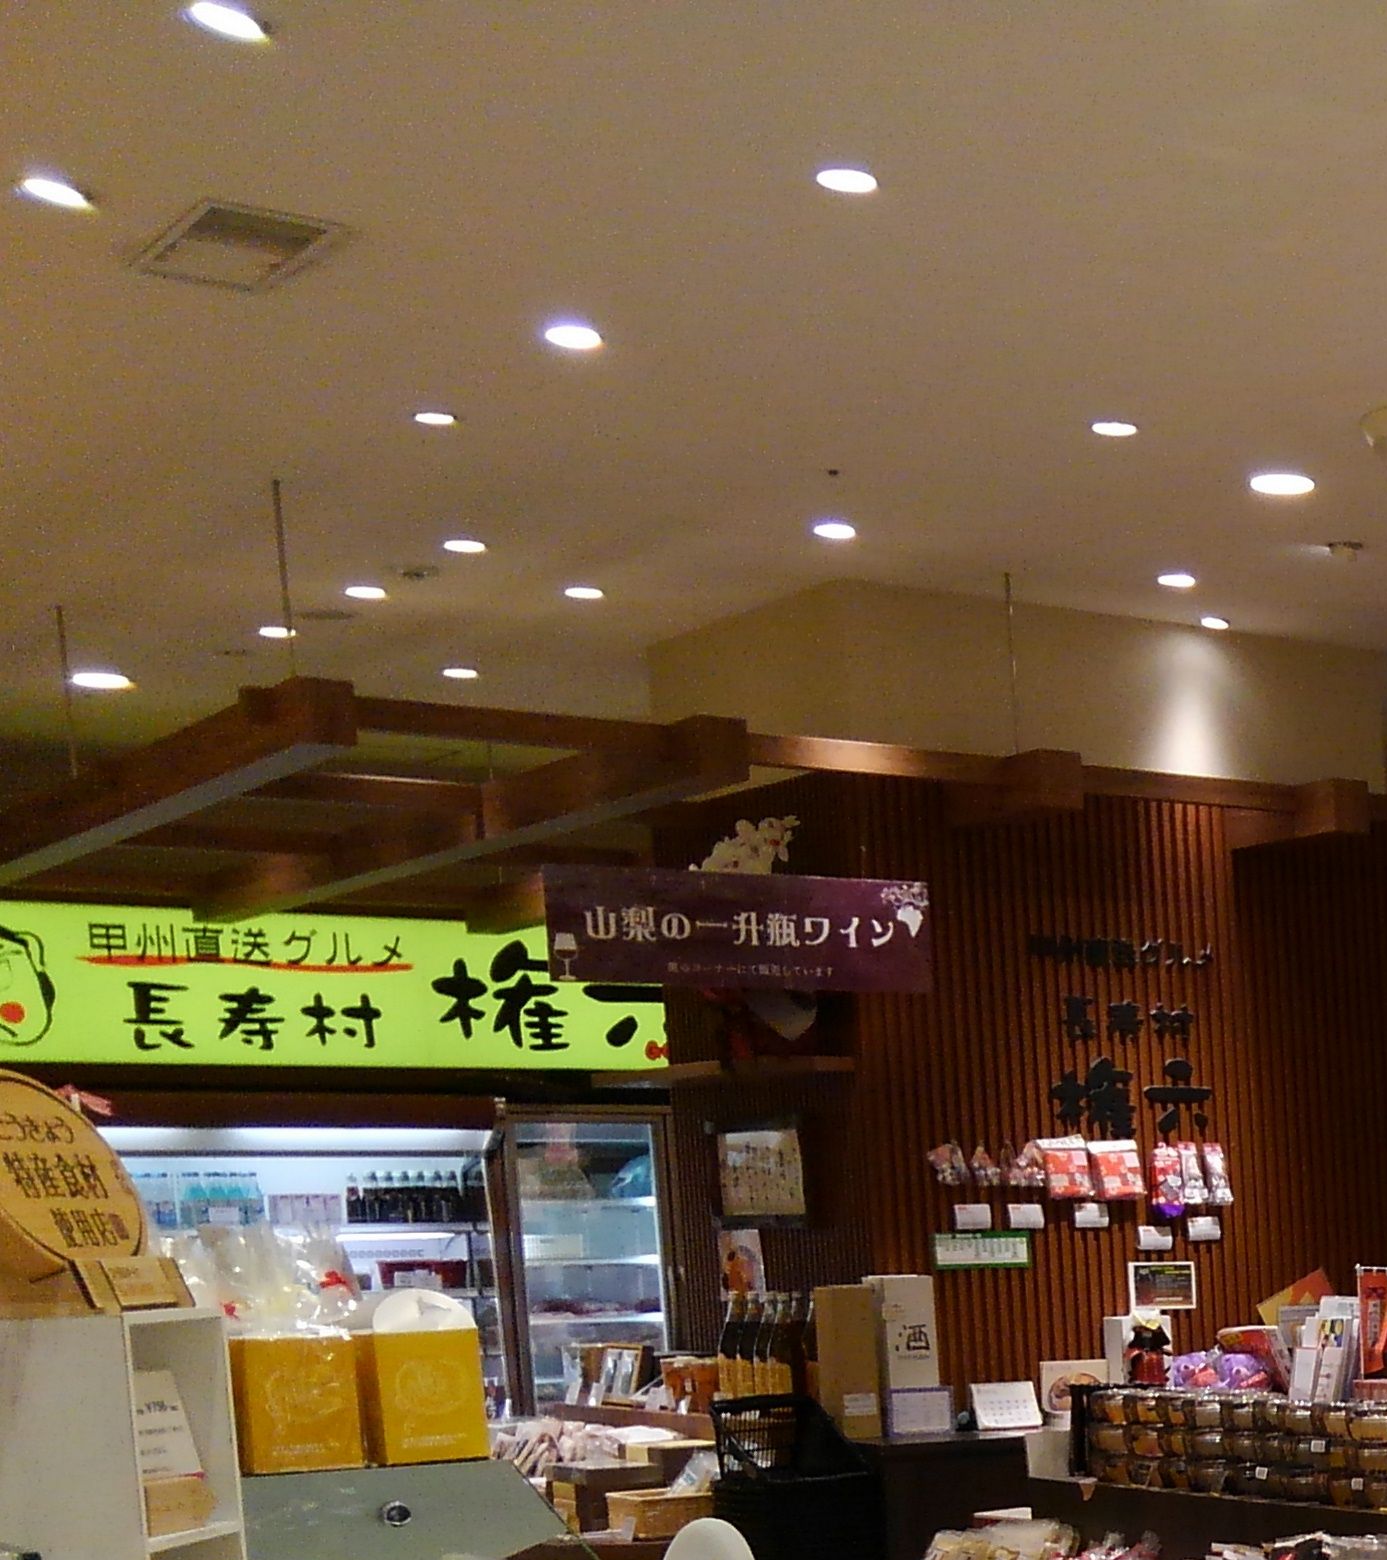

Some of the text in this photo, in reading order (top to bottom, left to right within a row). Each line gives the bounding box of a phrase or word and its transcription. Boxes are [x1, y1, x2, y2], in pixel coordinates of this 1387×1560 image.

[87, 922, 404, 968] 甲州直送グルメ
[585, 905, 894, 948] 山梨の一升瓶ワイン
[125, 981, 381, 1052] 長寿村
[896, 1324, 930, 1352] 酒
